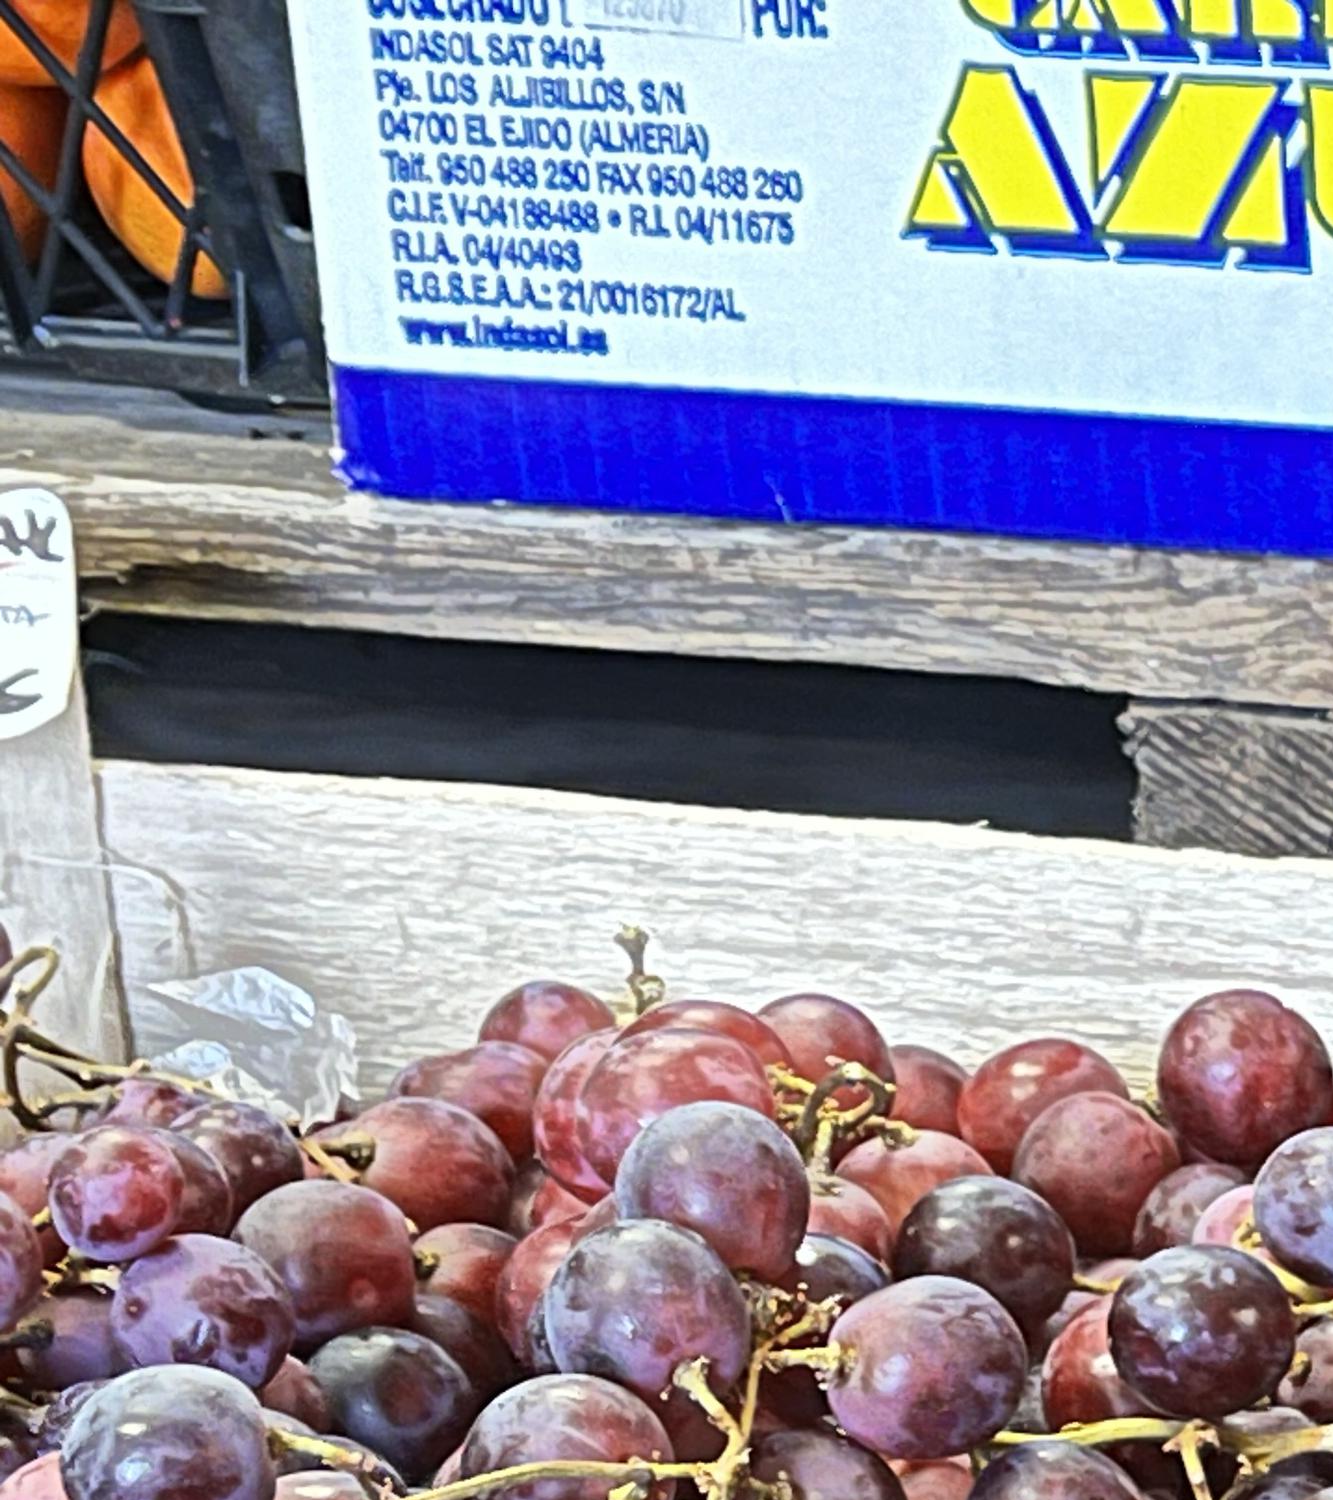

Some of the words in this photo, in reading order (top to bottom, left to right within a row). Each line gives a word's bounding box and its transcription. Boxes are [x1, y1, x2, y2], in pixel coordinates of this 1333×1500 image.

[369, 27, 484, 66] INDASOL
[486, 33, 534, 67] SAT
[539, 34, 605, 71] 9404
[426, 70, 478, 105] LOS
[639, 78, 687, 115] S/N
[378, 108, 458, 145] 04700
[464, 113, 496, 147] EL
[500, 115, 572, 151] EJIDO
[579, 119, 710, 163] (ALMERIA)
[437, 151, 485, 186] 950
[490, 155, 538, 190] 488
[543, 157, 590, 192] 250
[596, 160, 644, 196] FAX
[647, 162, 695, 199] 950
[700, 166, 748, 201] 488
[753, 167, 803, 203] 260
[387, 188, 448, 225] C.I.F.
[675, 205, 795, 246] 04/11675
